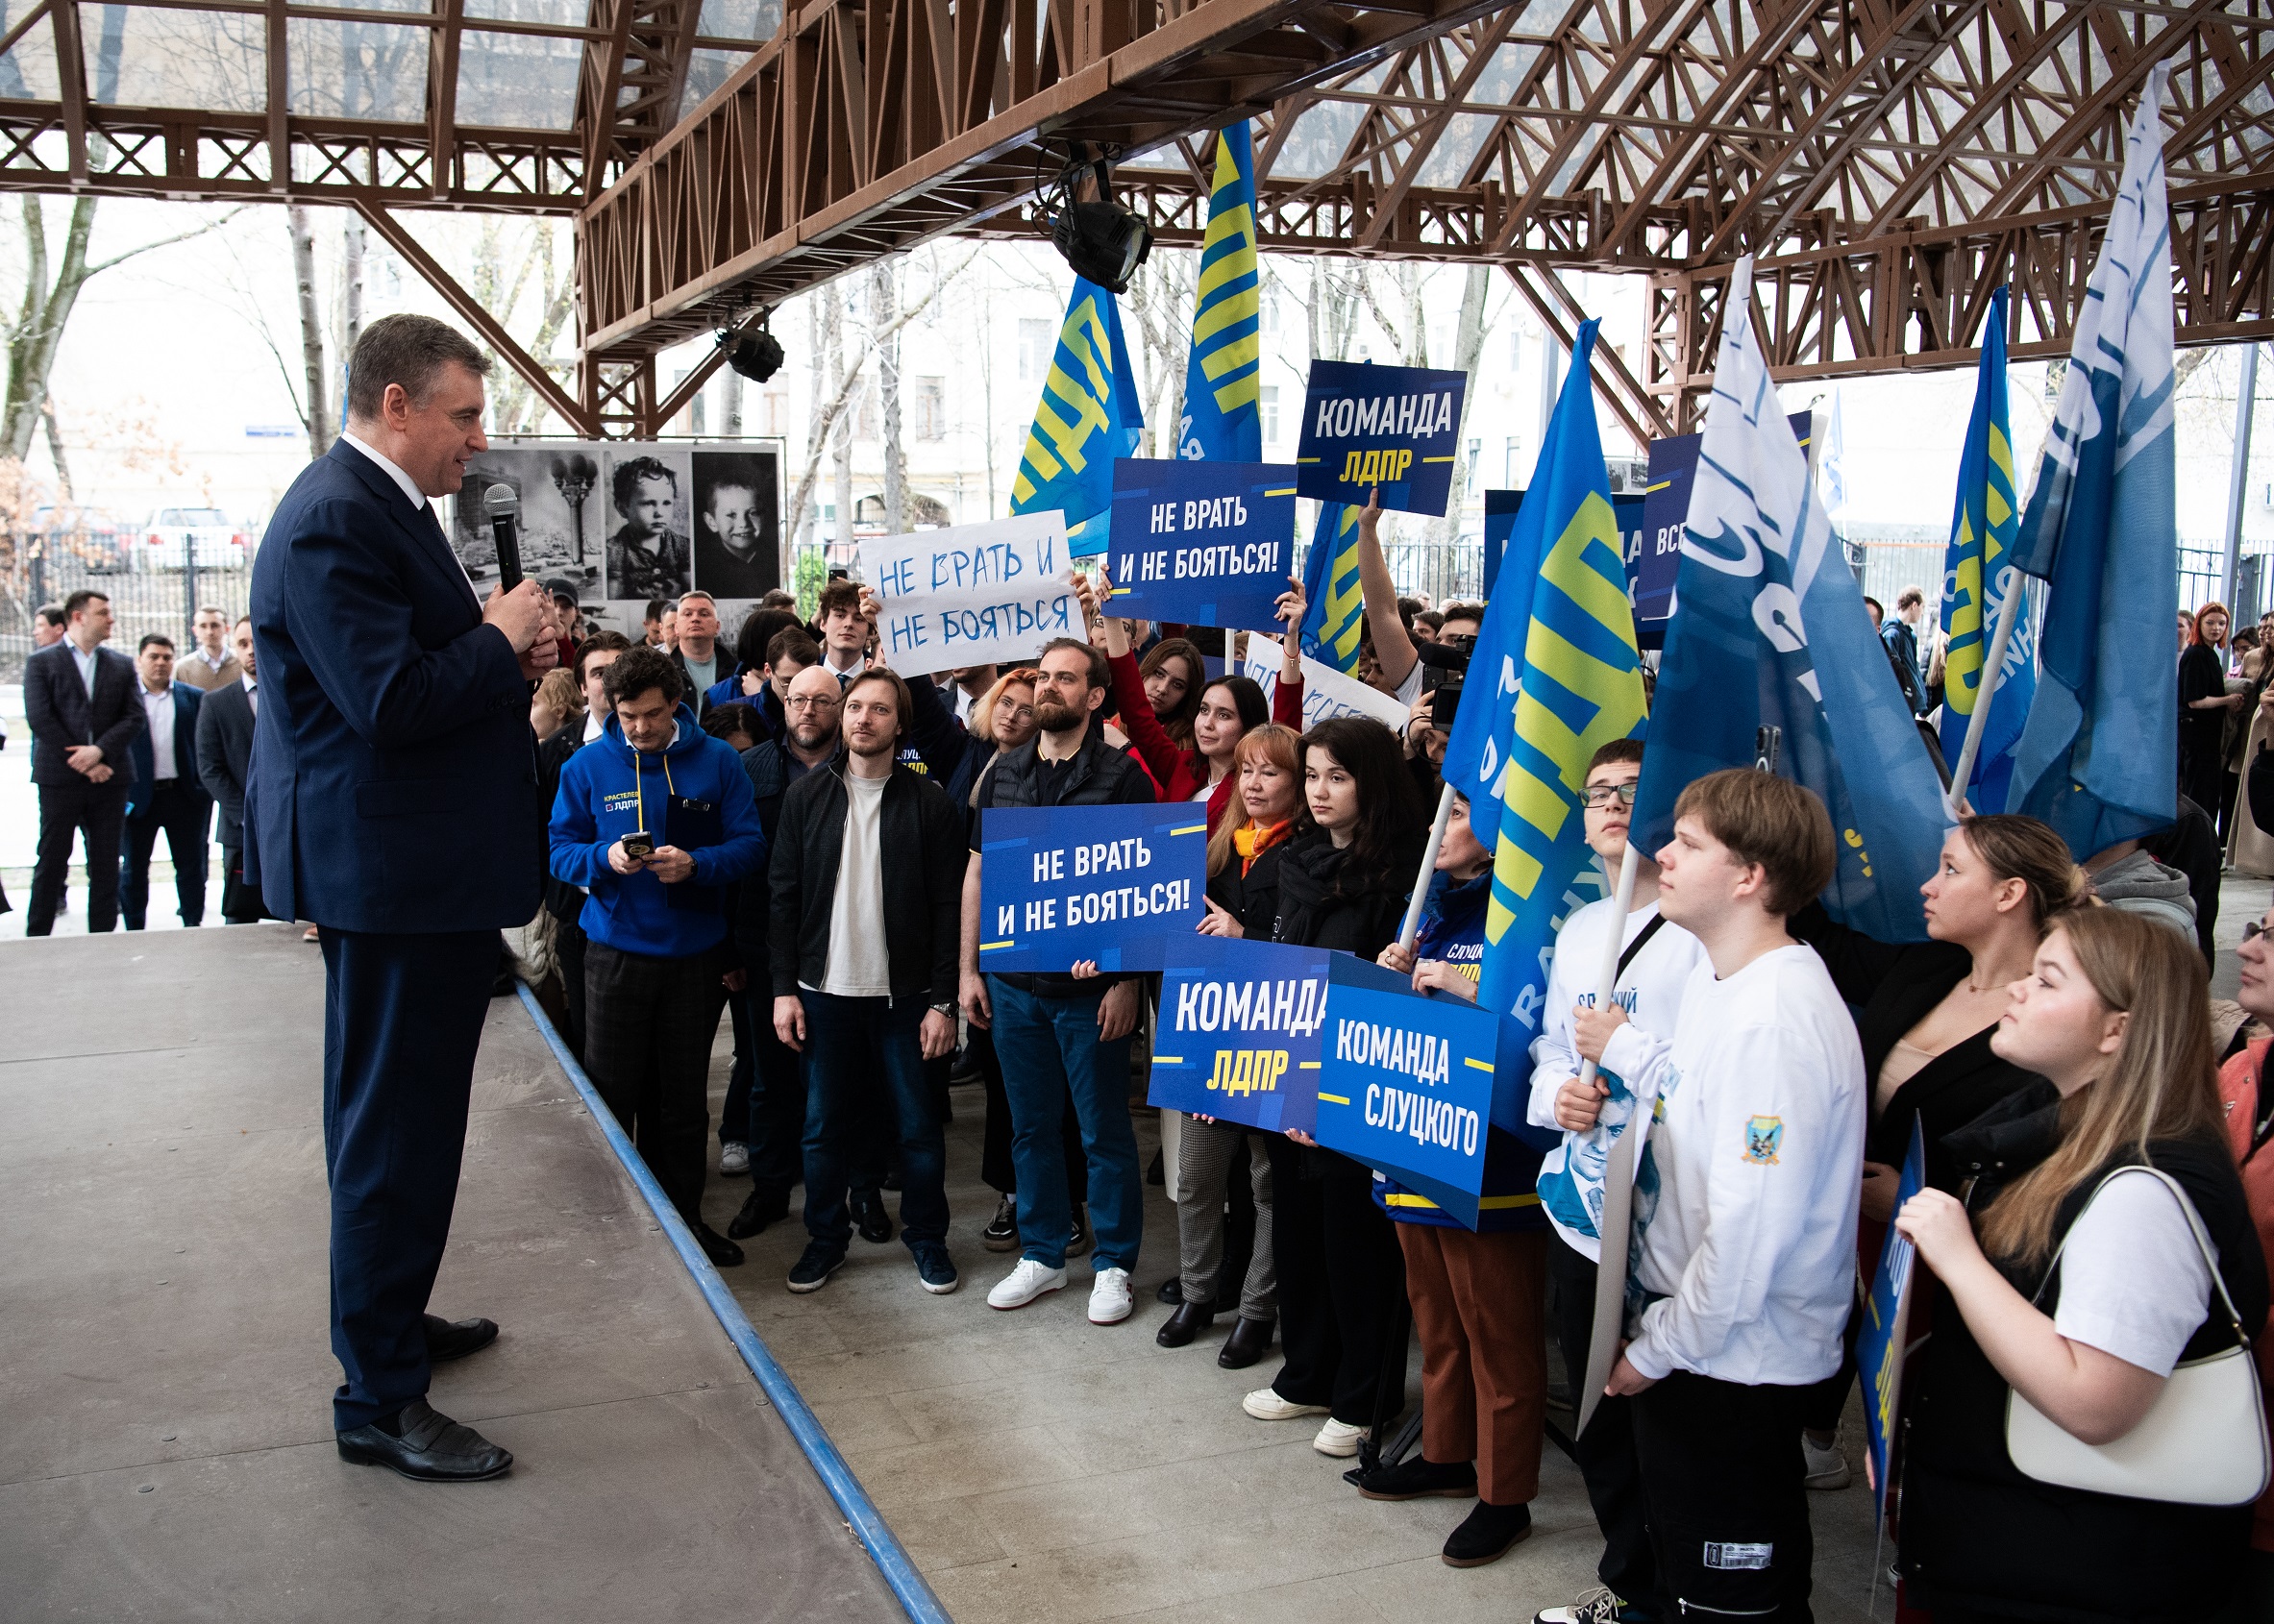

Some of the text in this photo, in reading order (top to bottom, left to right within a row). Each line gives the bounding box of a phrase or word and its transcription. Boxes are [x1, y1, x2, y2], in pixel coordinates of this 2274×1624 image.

[1315, 391, 1451, 439] КОМАНДА
[1339, 449, 1413, 487] ЛДПР
[1150, 496, 1248, 534] НЕ ВРАТЬ
[879, 535, 1053, 600] НЕ ВРАТЬ И
[1119, 541, 1279, 583] И НЕ БОЯТЬСЯ!
[890, 594, 1071, 654] НЕ БОЯТЬСЯ
[1033, 837, 1151, 882] НЕ ВРАТЬ
[998, 878, 1190, 936] И НЕ БОЯТЬСЯ!
[1206, 1049, 1289, 1097] ЛДПР
[1336, 1018, 1449, 1087] КОМАНДА
[1365, 1083, 1479, 1157] СЛУЦКОГО
